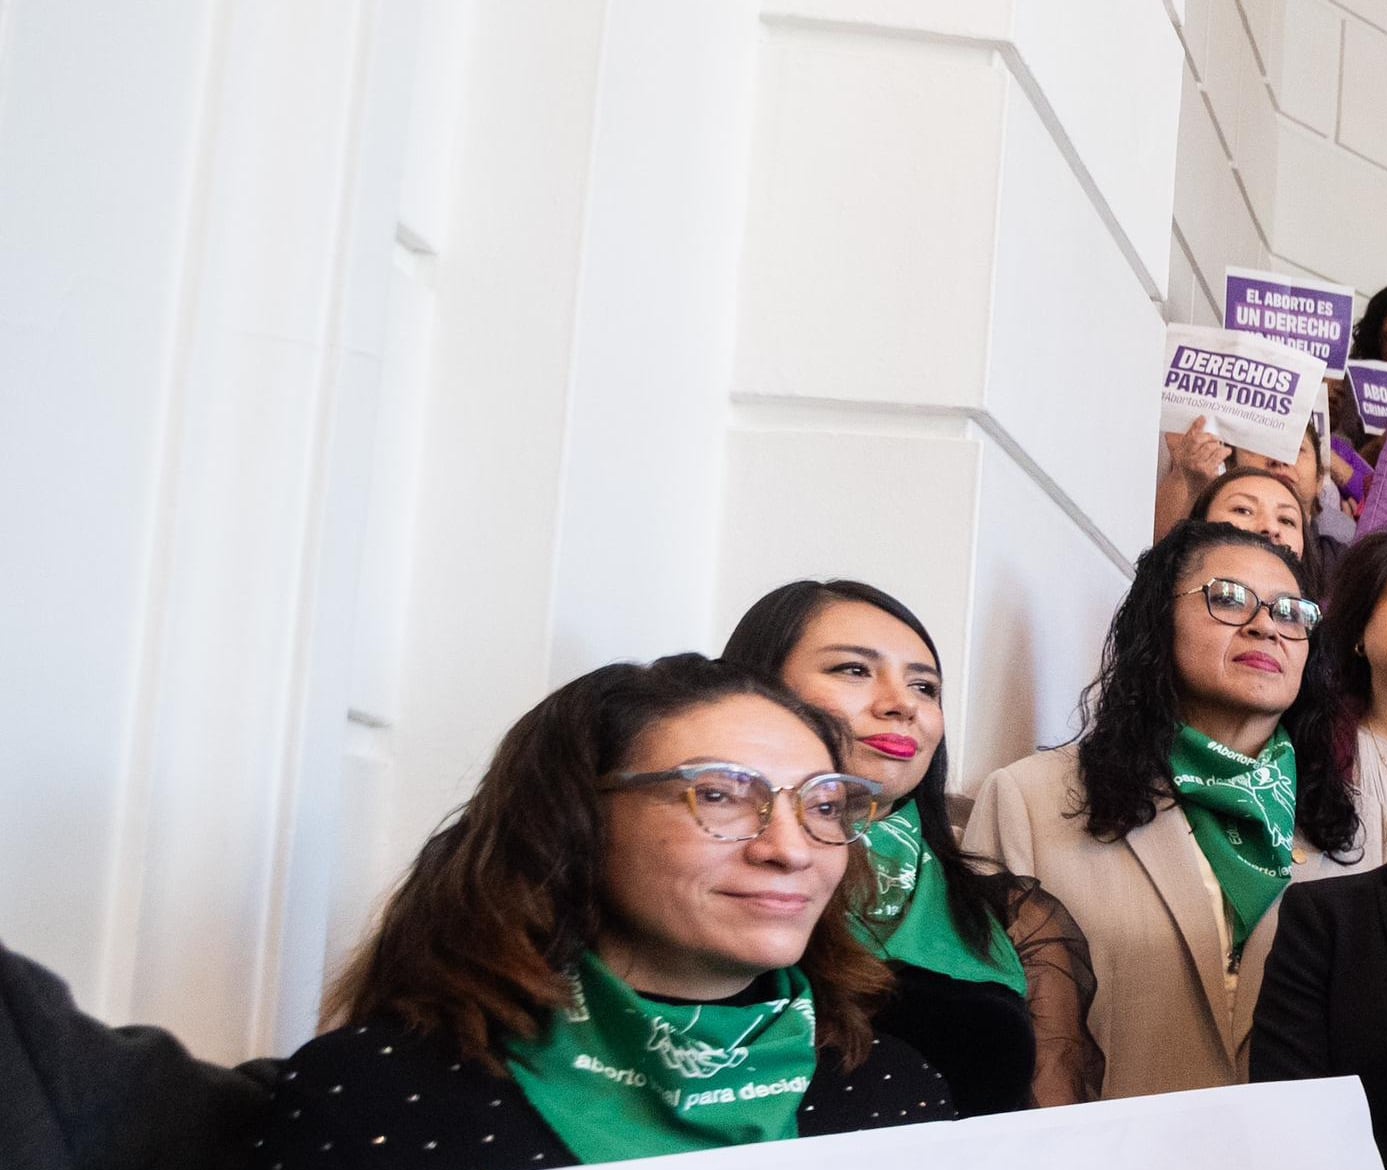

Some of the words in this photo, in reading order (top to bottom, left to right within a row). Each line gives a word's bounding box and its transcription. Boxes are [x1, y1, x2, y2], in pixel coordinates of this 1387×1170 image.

[1246, 289, 1262, 304] EL
[1264, 290, 1315, 315] ABORTO
[1317, 301, 1333, 316] ES
[1236, 306, 1260, 327] UN
[1264, 309, 1341, 341] DERECHO
[1178, 349, 1293, 393] DERECHOS
[1164, 370, 1218, 398] PARA
[1222, 382, 1293, 416] TODAS
[573, 1053, 648, 1088] aborto
[683, 1086, 736, 1112] para
